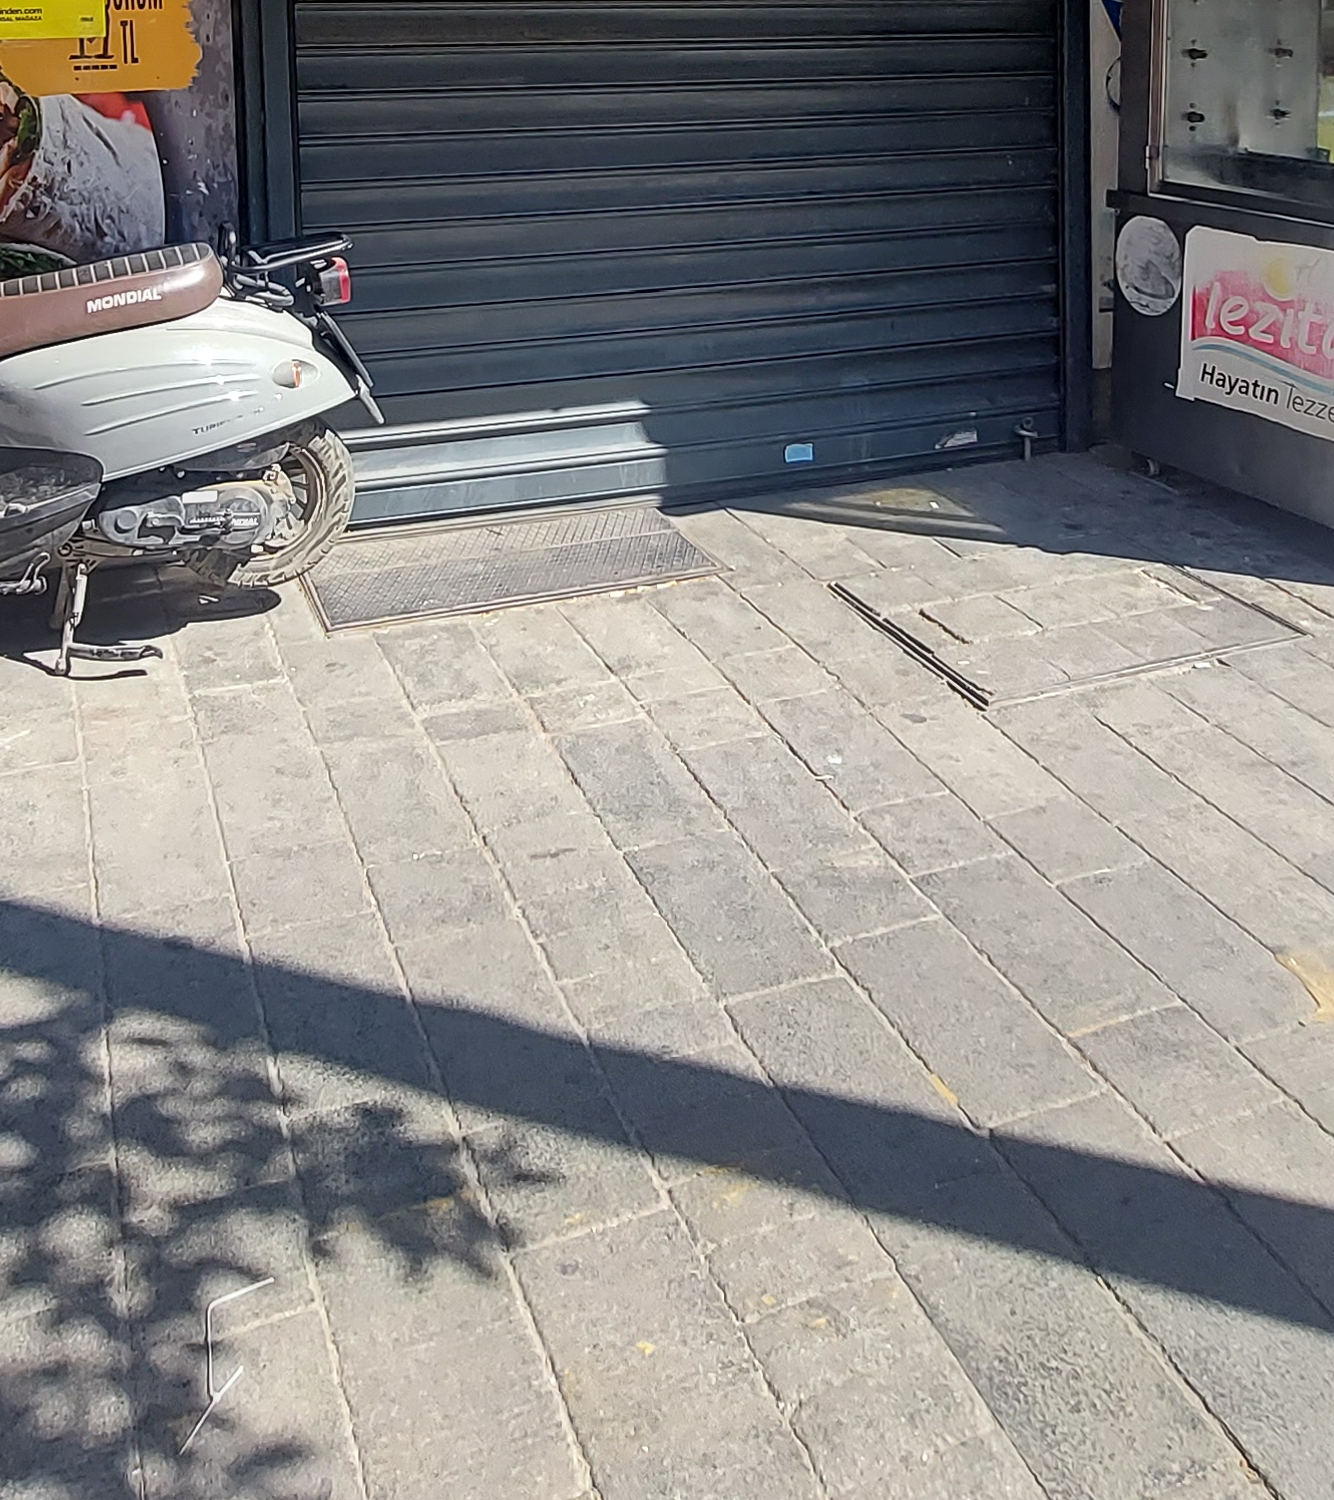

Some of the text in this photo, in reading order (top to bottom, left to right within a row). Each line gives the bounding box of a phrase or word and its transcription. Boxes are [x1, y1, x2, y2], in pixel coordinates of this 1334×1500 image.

[120, 19, 139, 65] TL
[87, 286, 162, 314] MONDIAL
[1200, 363, 1279, 405] Hayatın
